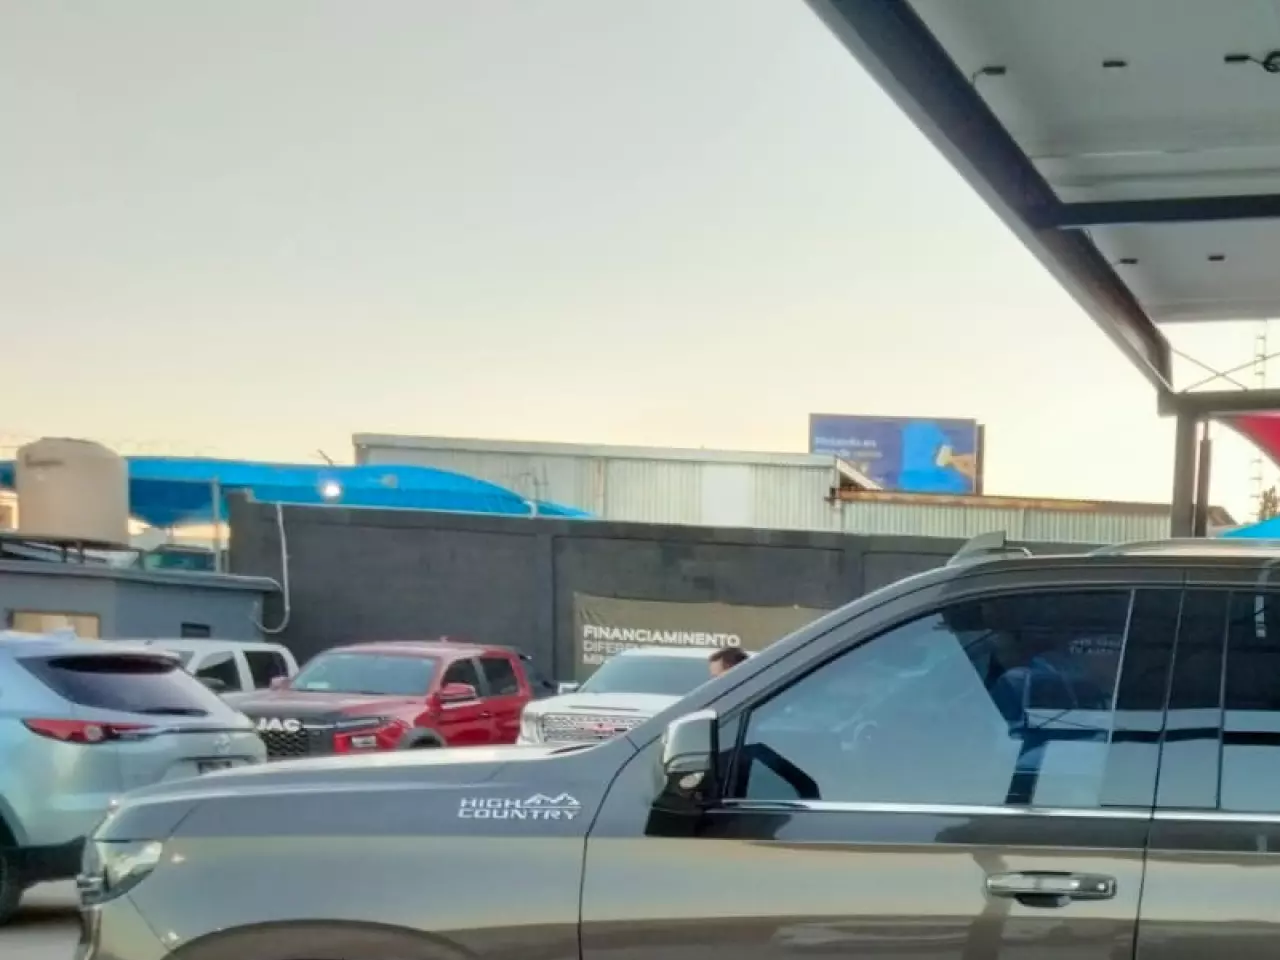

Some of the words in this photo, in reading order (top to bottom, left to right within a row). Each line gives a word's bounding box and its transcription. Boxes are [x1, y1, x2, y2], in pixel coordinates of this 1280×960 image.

[583, 624, 740, 647] FINANCIAMINENTO
[257, 717, 300, 732] JAC
[460, 797, 521, 809] HIGH
[458, 808, 577, 820] COUNTRY
